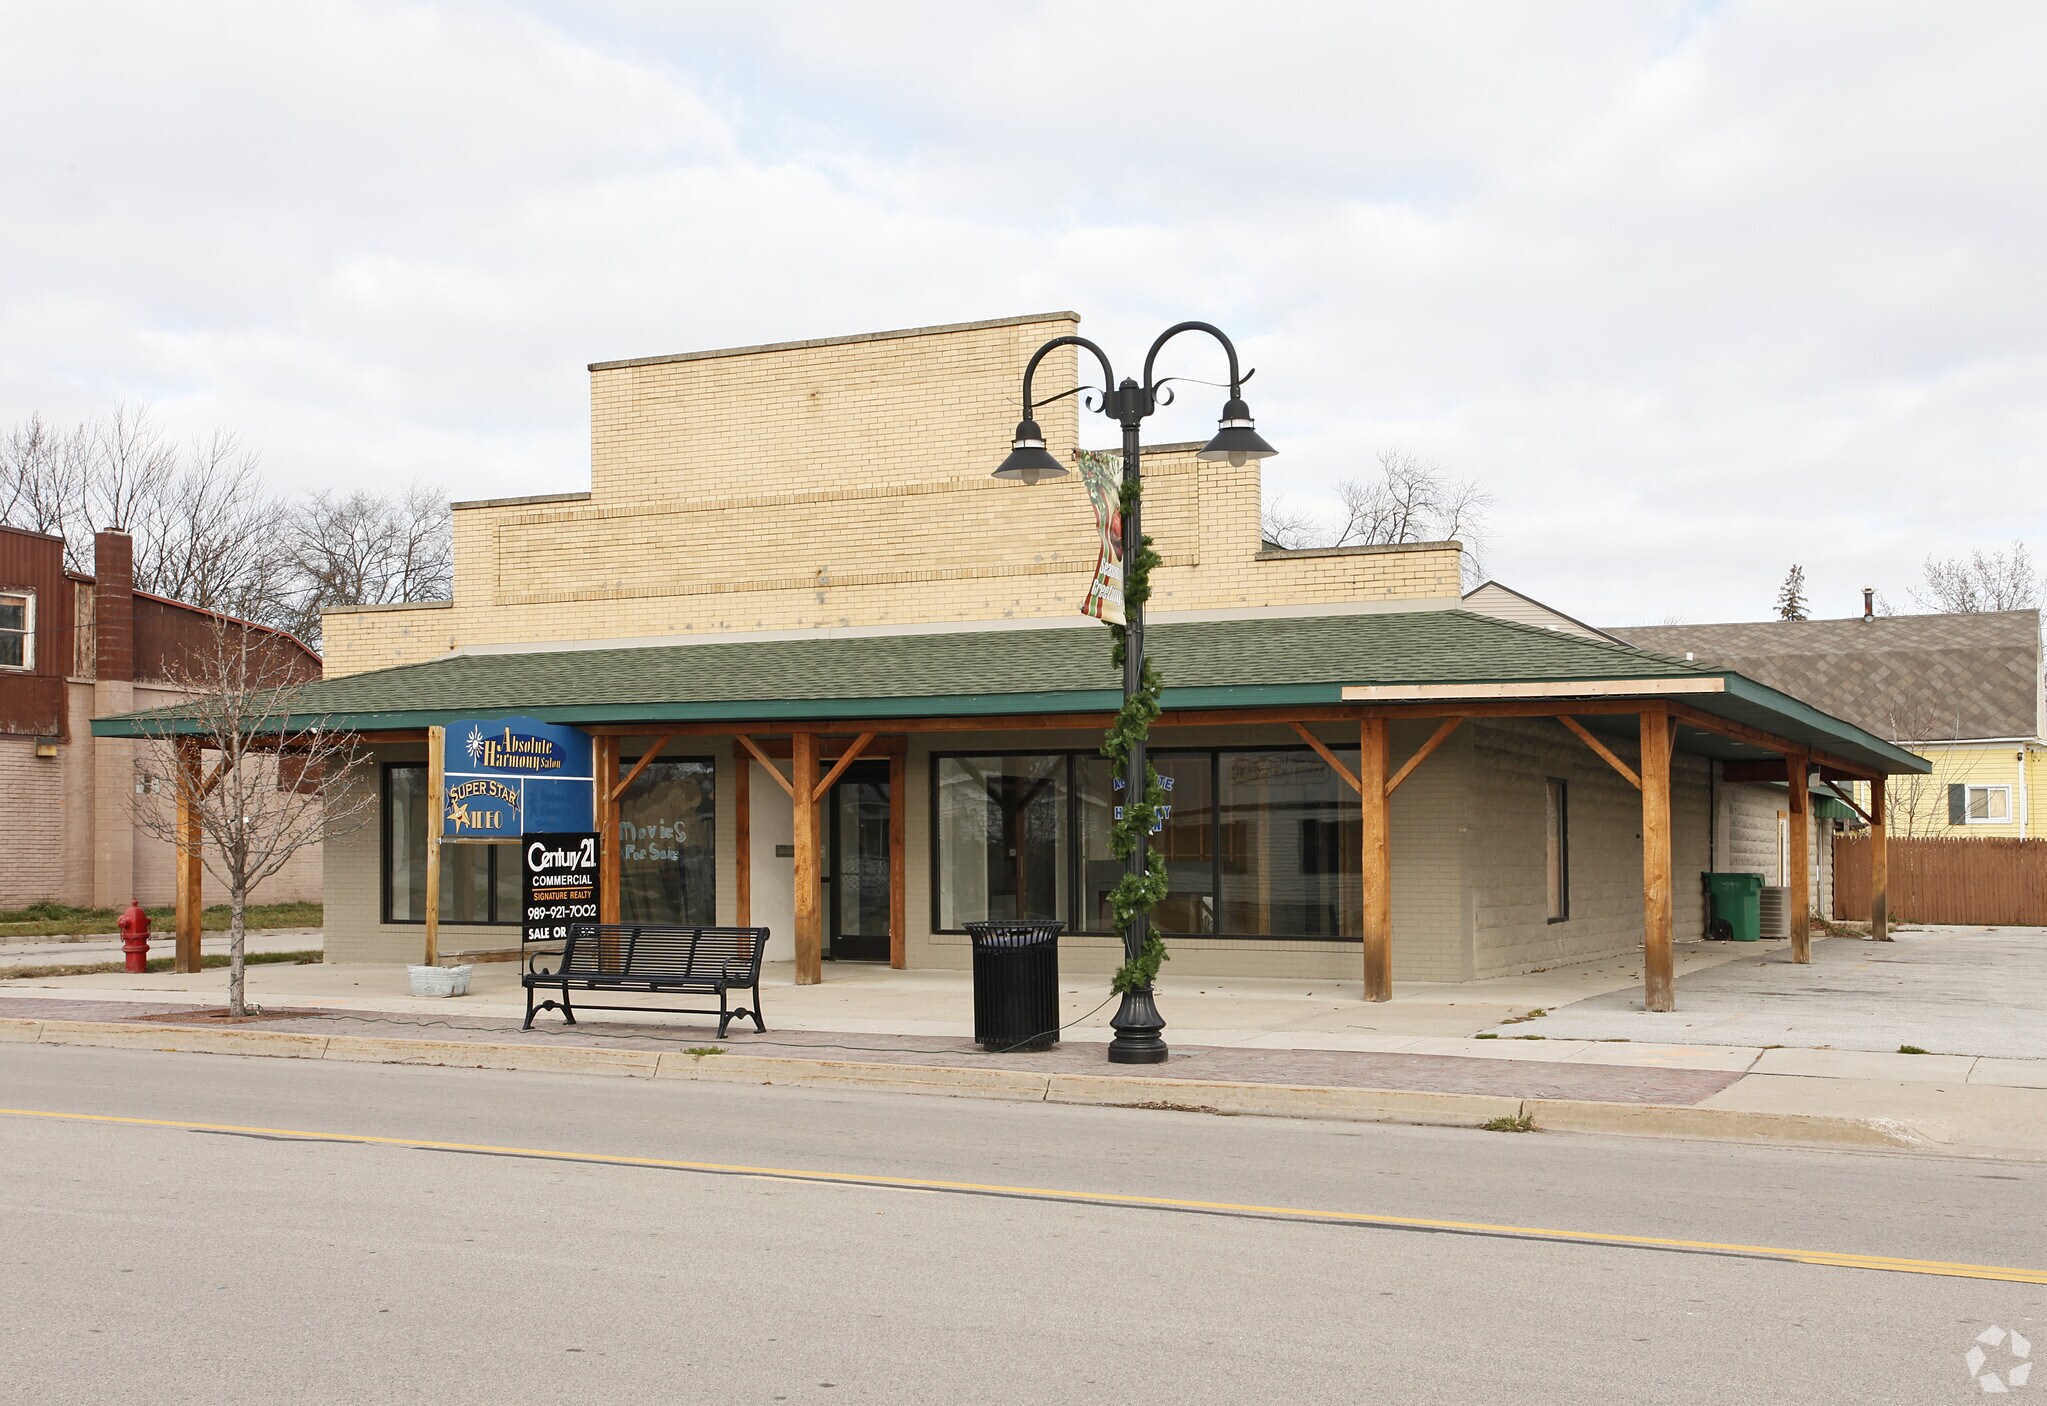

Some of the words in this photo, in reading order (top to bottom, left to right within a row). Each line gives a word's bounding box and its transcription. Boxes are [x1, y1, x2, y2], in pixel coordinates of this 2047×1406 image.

[496, 726, 553, 754] Absolute
[483, 740, 540, 771] Harmony
[540, 757, 561, 768] Salon
[449, 782, 487, 803] SUPER
[489, 780, 516, 805] STAR
[527, 842, 581, 872] Century
[532, 875, 592, 886] COMMERCIAL
[533, 891, 567, 900] SIGNATURE
[570, 891, 592, 899] REALTY
[527, 904, 597, 920] 989-921-7002
[528, 927, 550, 940] SALE
[552, 926, 567, 938] OR
